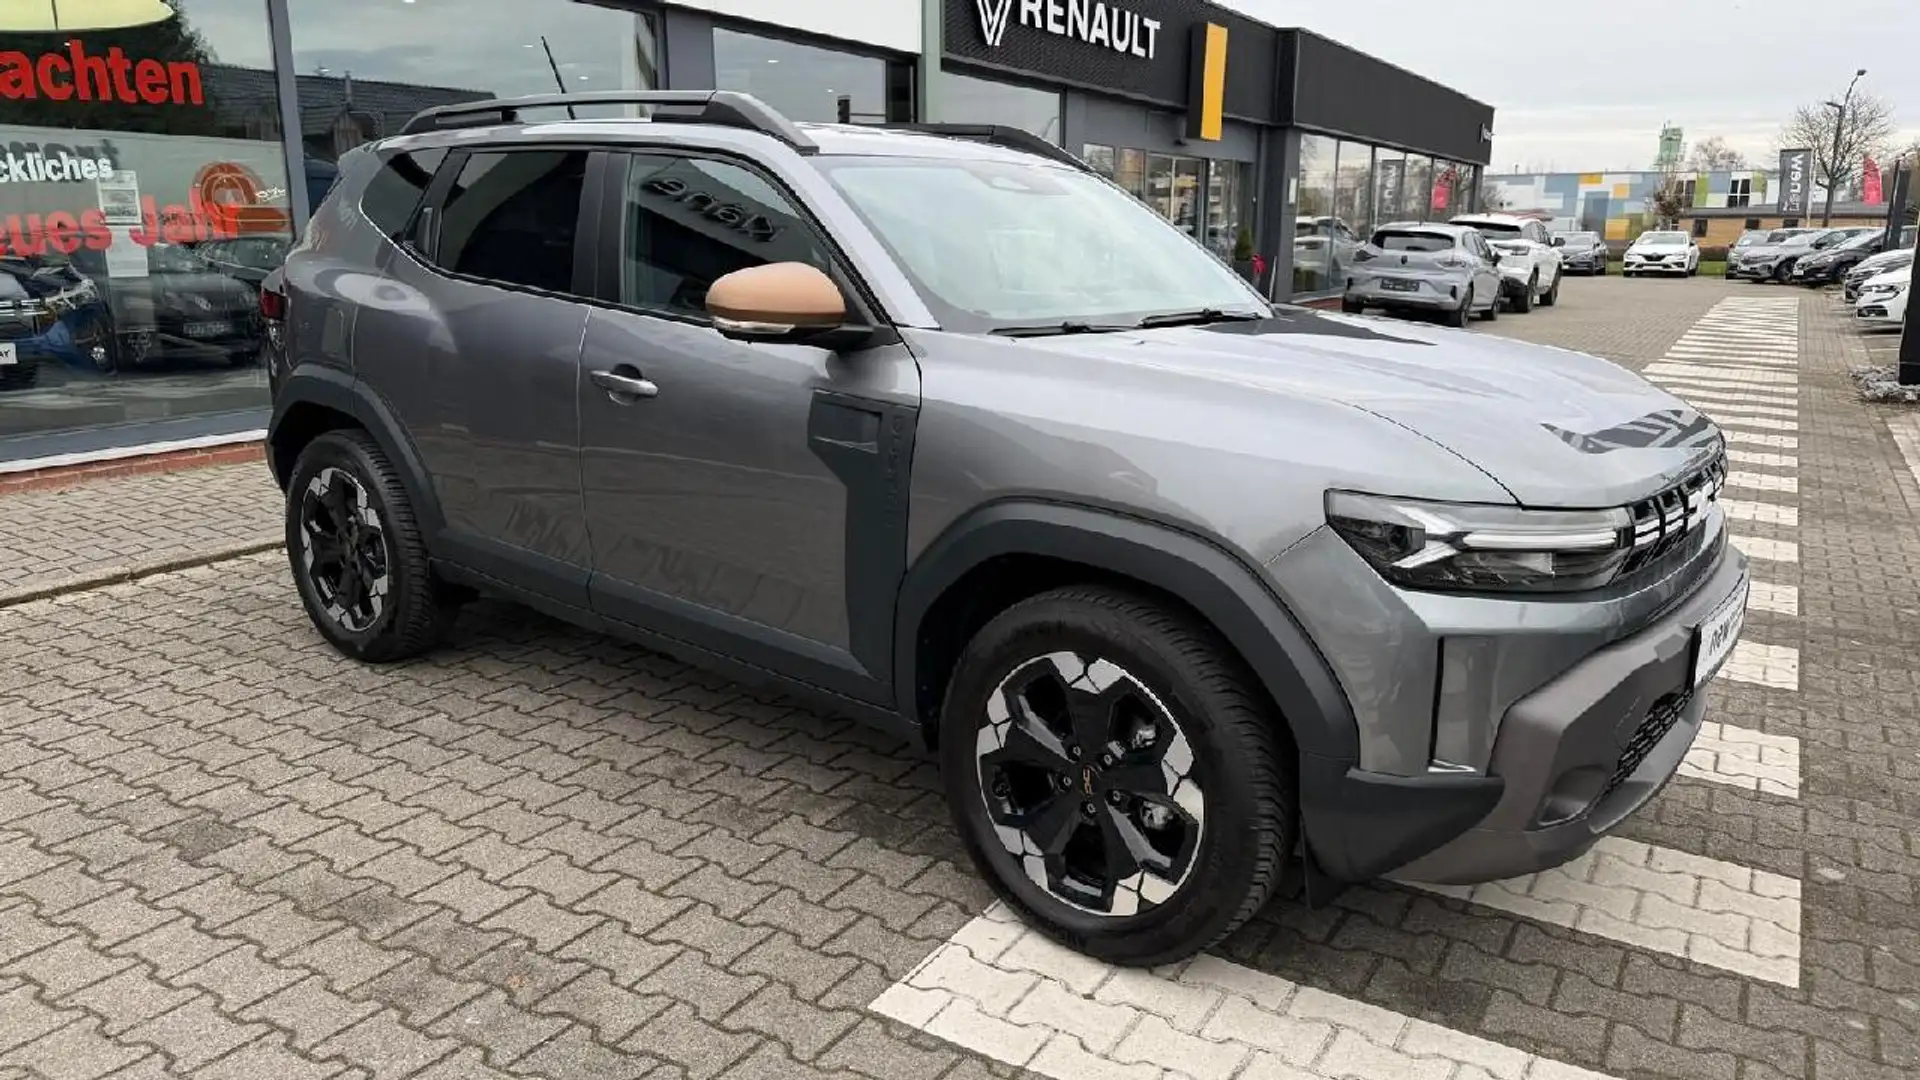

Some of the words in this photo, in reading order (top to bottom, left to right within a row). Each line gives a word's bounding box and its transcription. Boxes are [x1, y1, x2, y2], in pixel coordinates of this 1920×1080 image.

[1020, 0, 1160, 59] RENAULT
[0, 39, 204, 105] achten
[0, 210, 113, 257] ues
